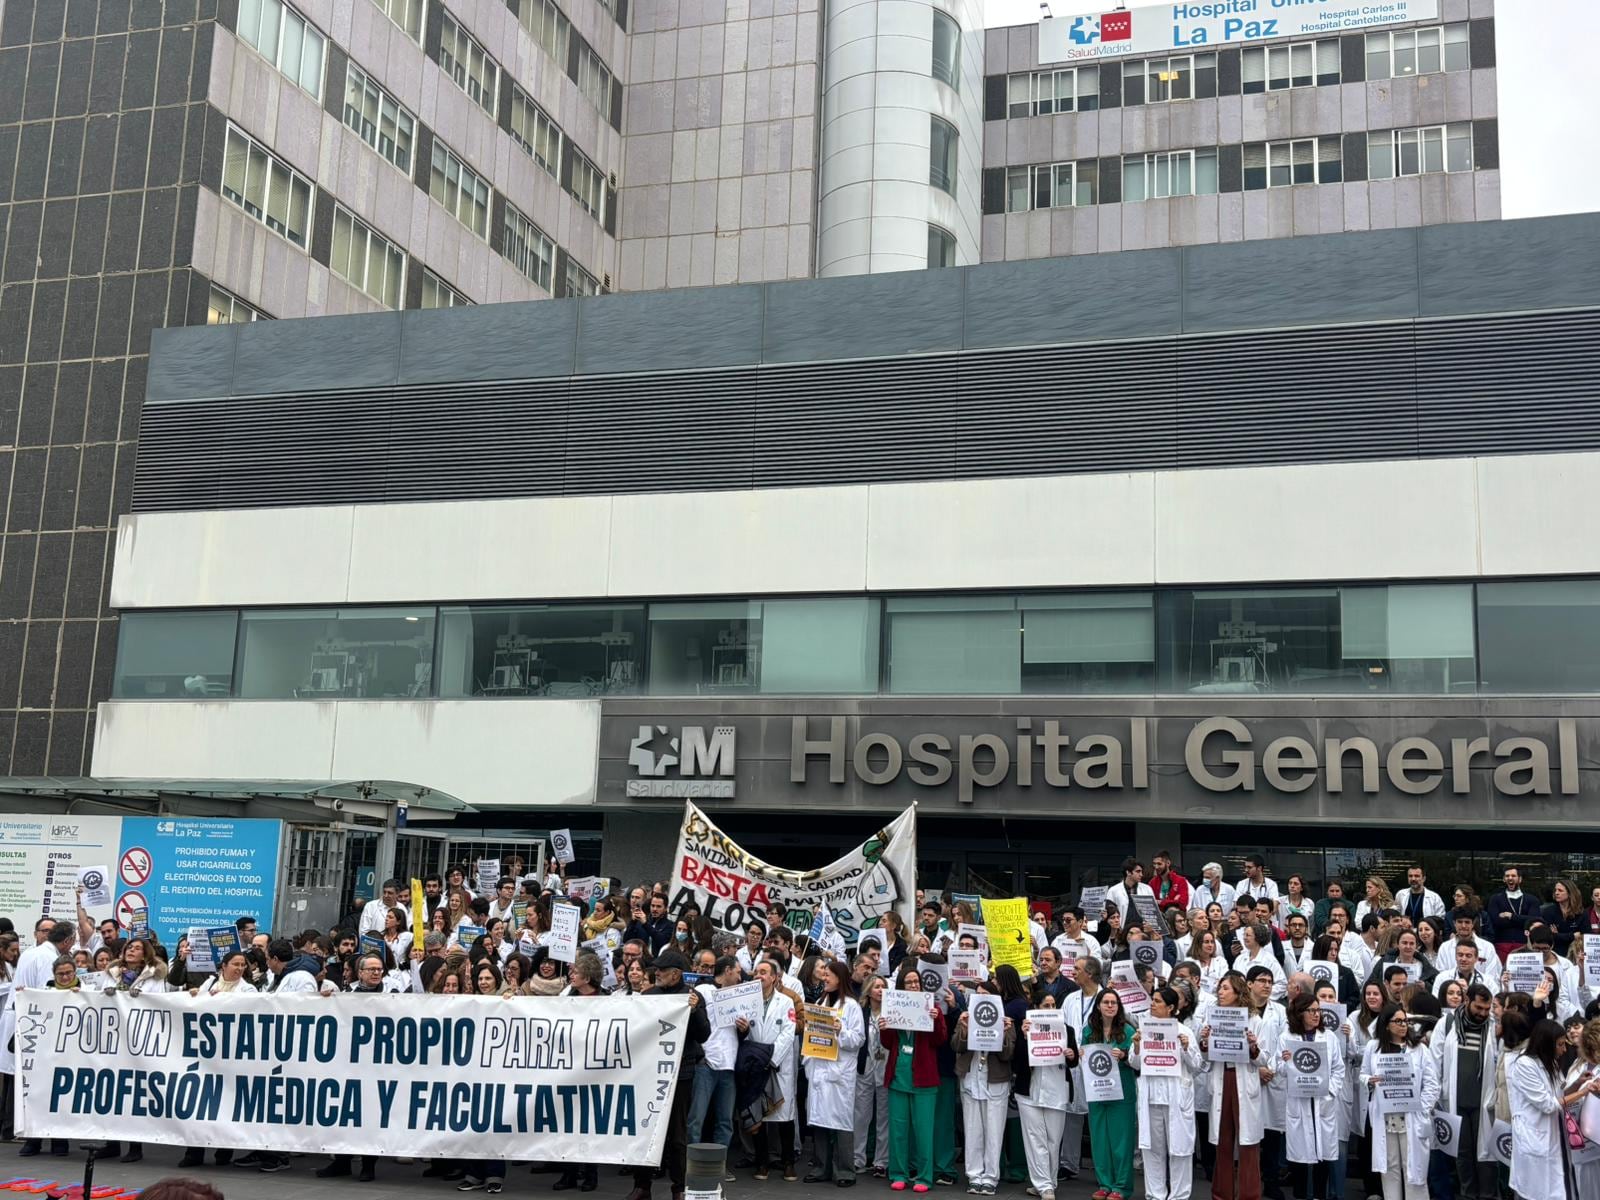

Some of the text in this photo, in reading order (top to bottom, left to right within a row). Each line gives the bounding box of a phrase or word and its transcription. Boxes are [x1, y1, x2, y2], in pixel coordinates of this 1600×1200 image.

[1173, 0, 1257, 19] Hospital
[1319, 3, 1407, 20] Hospital Carlos III
[1173, 18, 1279, 46] La Paz
[1301, 13, 1407, 32] Hospital Cantoblanco
[1067, 43, 1132, 59] SaludMadrid
[790, 716, 1580, 802] Hospital General
[175, 829, 185, 837] La
[186, 829, 202, 837] Paz
[175, 847, 256, 857] PROHIBIDO FUMAR Y
[685, 837, 738, 869] SANIDAD
[176, 860, 252, 870] USAR CIGARRILLOS
[164, 872, 262, 884] ELECTRÓNICOS EN TODO
[681, 855, 772, 910] BASTA
[160, 885, 263, 897] EL RECINTO DEL HOSPITAL
[768, 885, 858, 906] DE MALTRATO
[190, 917, 219, 925] ESPACIOS
[55, 1005, 632, 1070] POR UN ESTATUTO PROPIO PARA LA
[49, 1061, 637, 1137] PROFESIÓN MÉDICA Y FACULTATIVA
